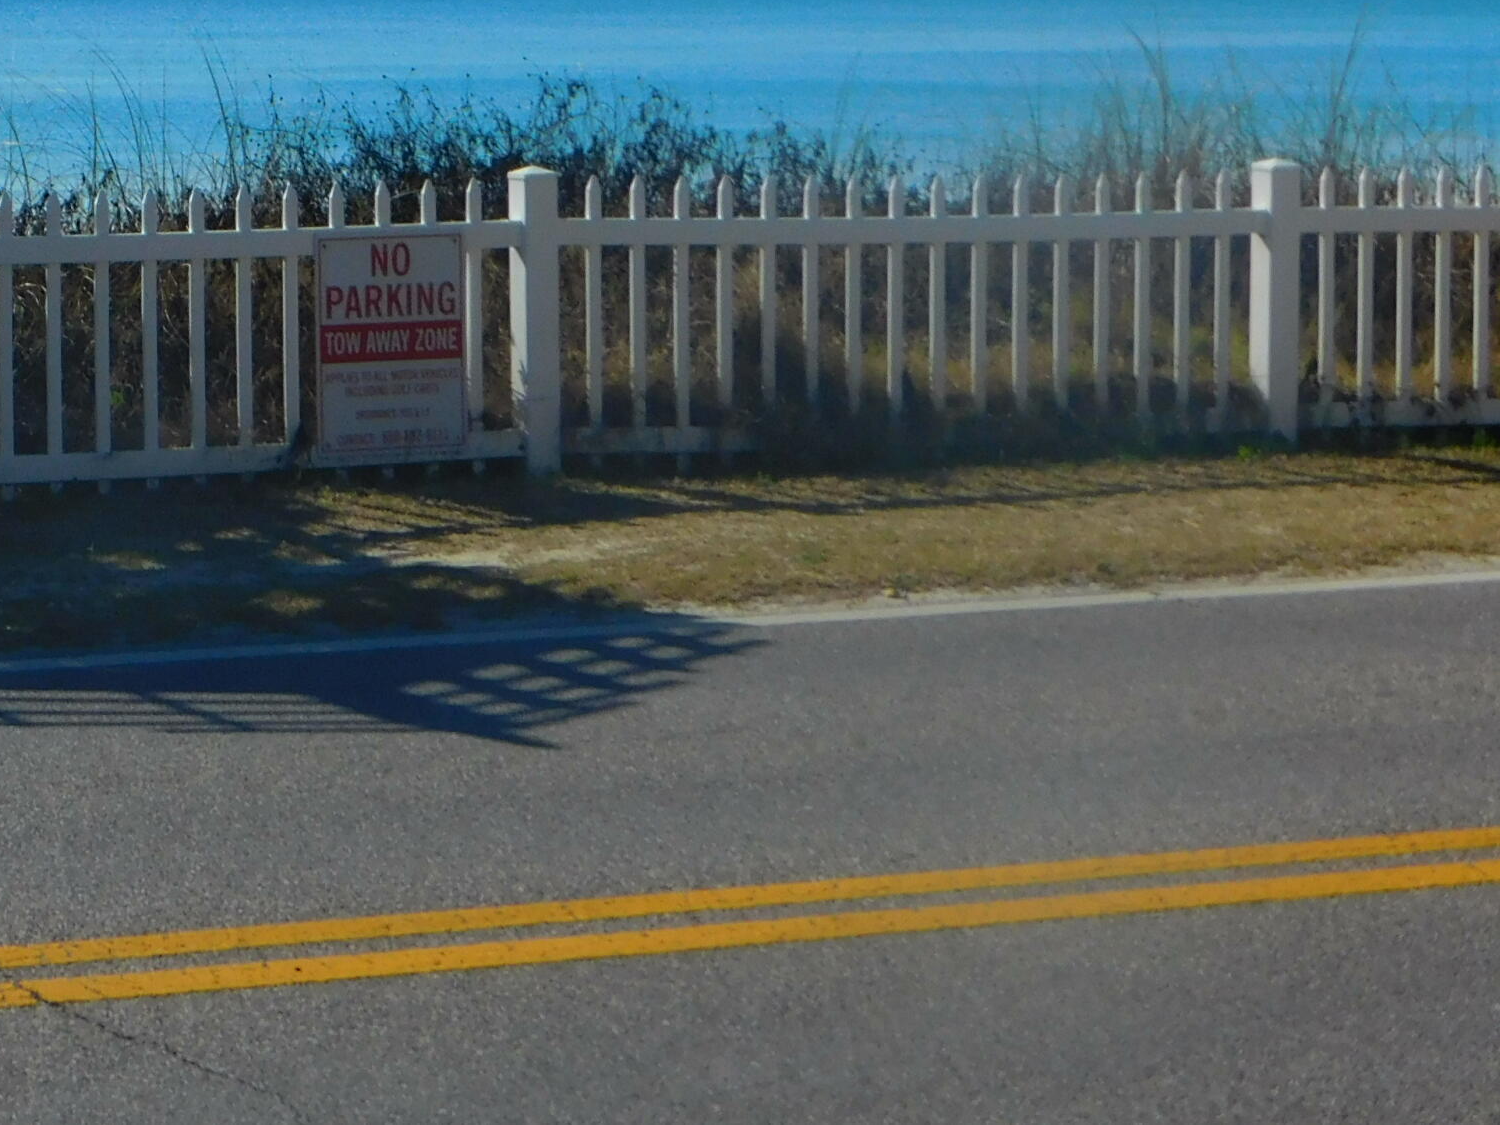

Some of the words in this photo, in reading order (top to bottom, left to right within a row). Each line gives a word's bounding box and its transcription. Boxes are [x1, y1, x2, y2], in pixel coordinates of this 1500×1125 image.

[370, 241, 411, 277] NO
[325, 281, 456, 320] PARKING
[325, 331, 362, 356] TOW
[365, 329, 411, 354] AWAY
[414, 327, 459, 352] ZONE
